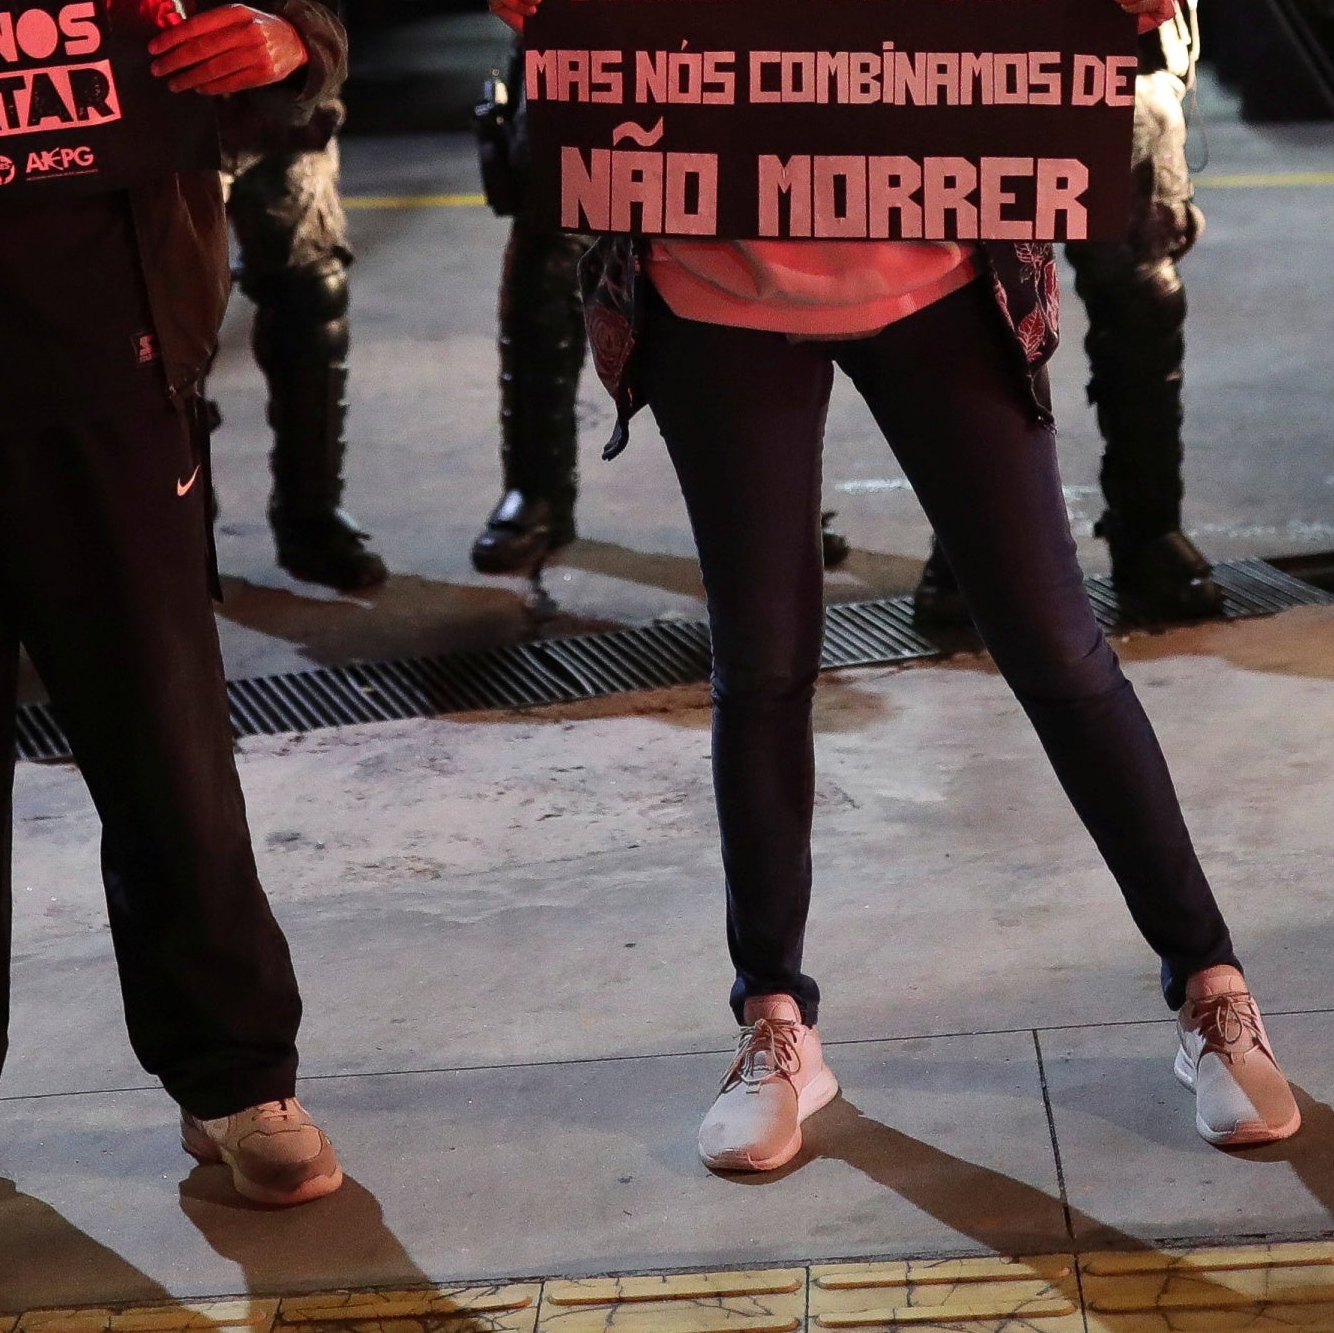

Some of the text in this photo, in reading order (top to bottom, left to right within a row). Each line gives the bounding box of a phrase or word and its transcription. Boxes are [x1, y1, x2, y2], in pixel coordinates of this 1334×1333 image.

[526, 49, 622, 103] MAS
[635, 39, 735, 104] NÓS
[1071, 54, 1137, 107] DE
[561, 116, 1089, 240] NÃO MORRER
